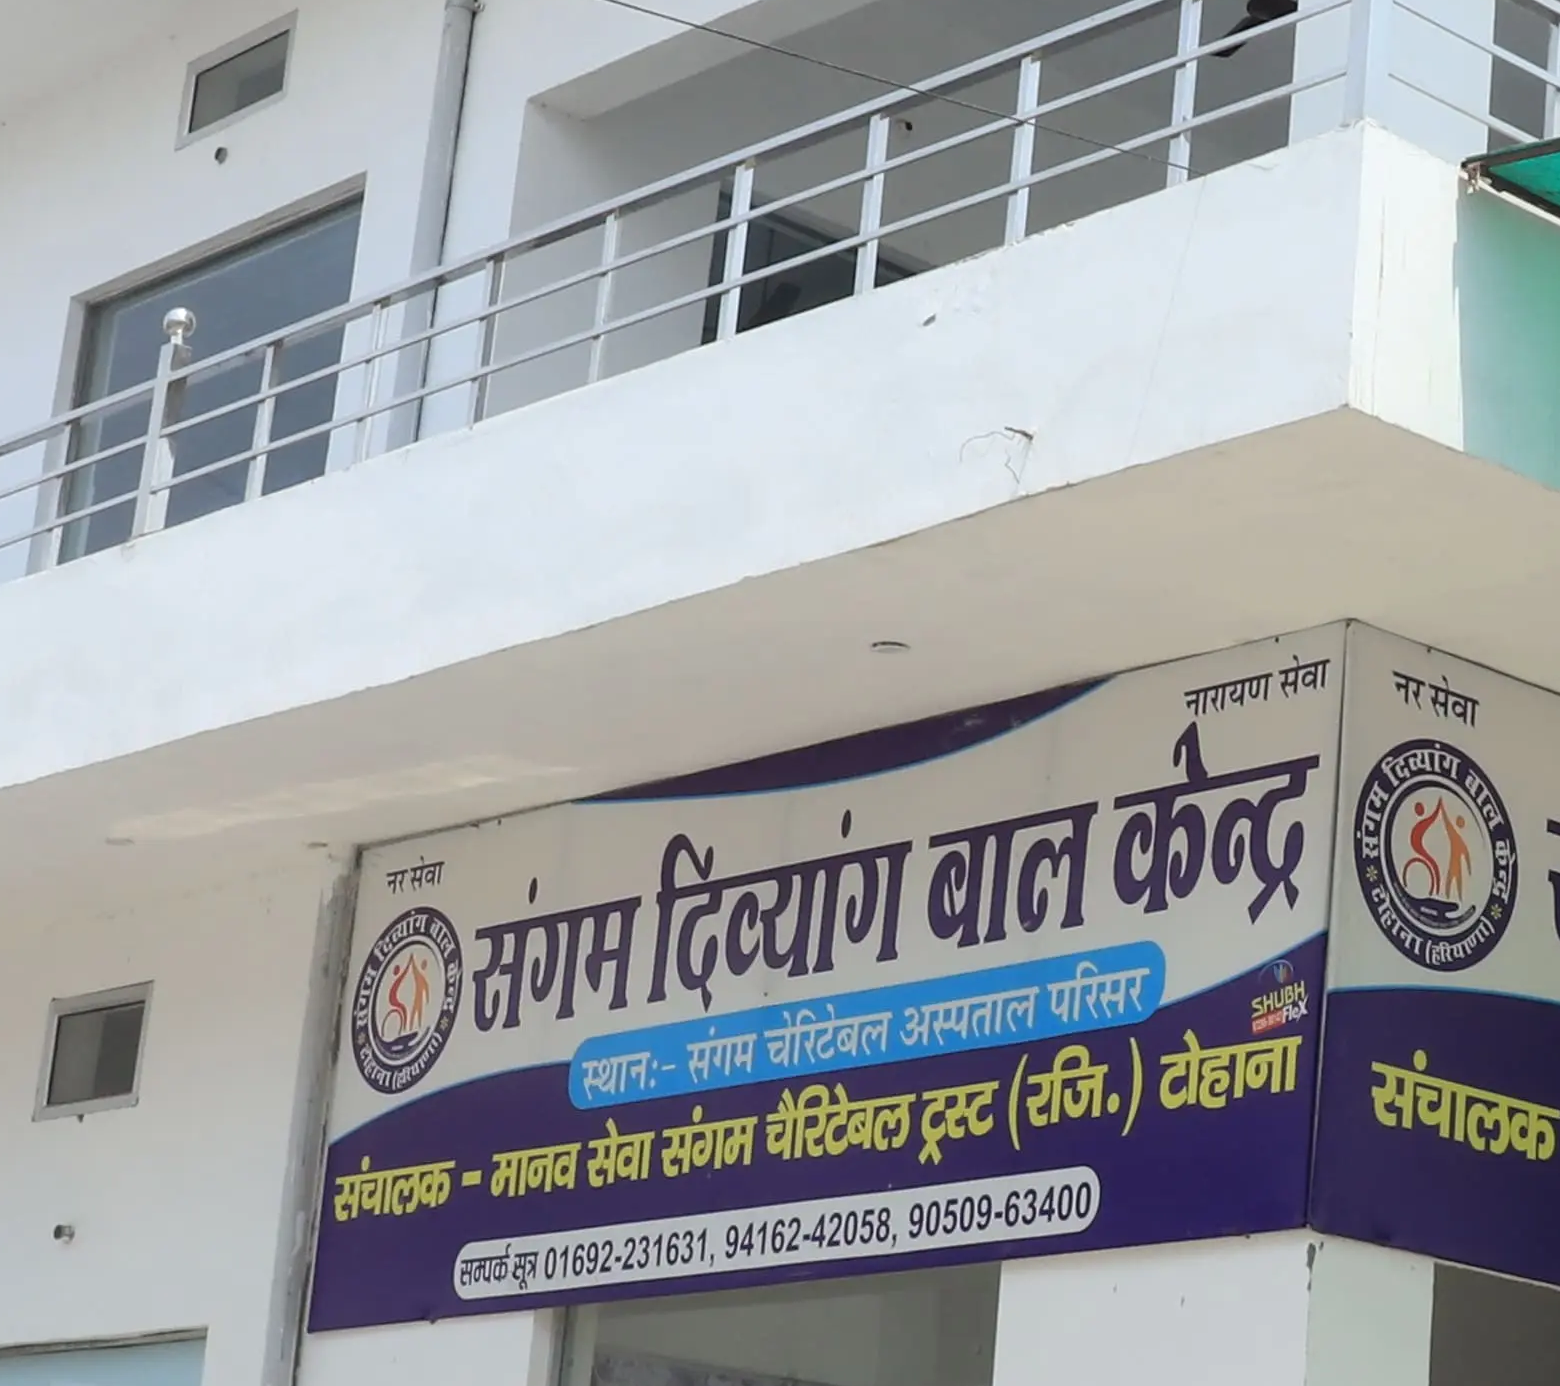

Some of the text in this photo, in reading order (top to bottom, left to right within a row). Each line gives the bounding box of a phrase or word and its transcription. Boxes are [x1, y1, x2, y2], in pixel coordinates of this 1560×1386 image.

[1184, 654, 1331, 716] नारायण सेवा
[1392, 669, 1480, 728] नर सेवा
[1356, 779, 1390, 860] संगम
[1381, 743, 1462, 789] दिव्यांग
[1463, 767, 1505, 832] बाल
[386, 855, 445, 895] नर सेवा
[472, 720, 1321, 1033] संगम दिव्यांग बाल केन्द्र
[1371, 883, 1424, 956] टोहाना
[1425, 914, 1496, 966] (हरियाणा)
[687, 1025, 757, 1085] संगम
[764, 1003, 893, 1068] चेरिटेबल
[899, 985, 1040, 1047] अस्पताल
[1047, 960, 1151, 1024] परिसर
[1251, 979, 1306, 1019] SHUBH
[333, 1155, 456, 1222] संचालक
[489, 1141, 582, 1198] मानव
[587, 1117, 655, 1188] सेवा
[660, 1104, 759, 1179] संगम
[765, 1082, 917, 1161] चैरिटेबल
[918, 1080, 1000, 1165] ट्रस्ट
[1158, 1027, 1303, 1111] टोहाना
[1370, 1048, 1560, 1161] संचालक
[459, 1180, 1093, 1291] सम्पर्क सूत्र 01692-231631, 94162-42058, 90509-63400
